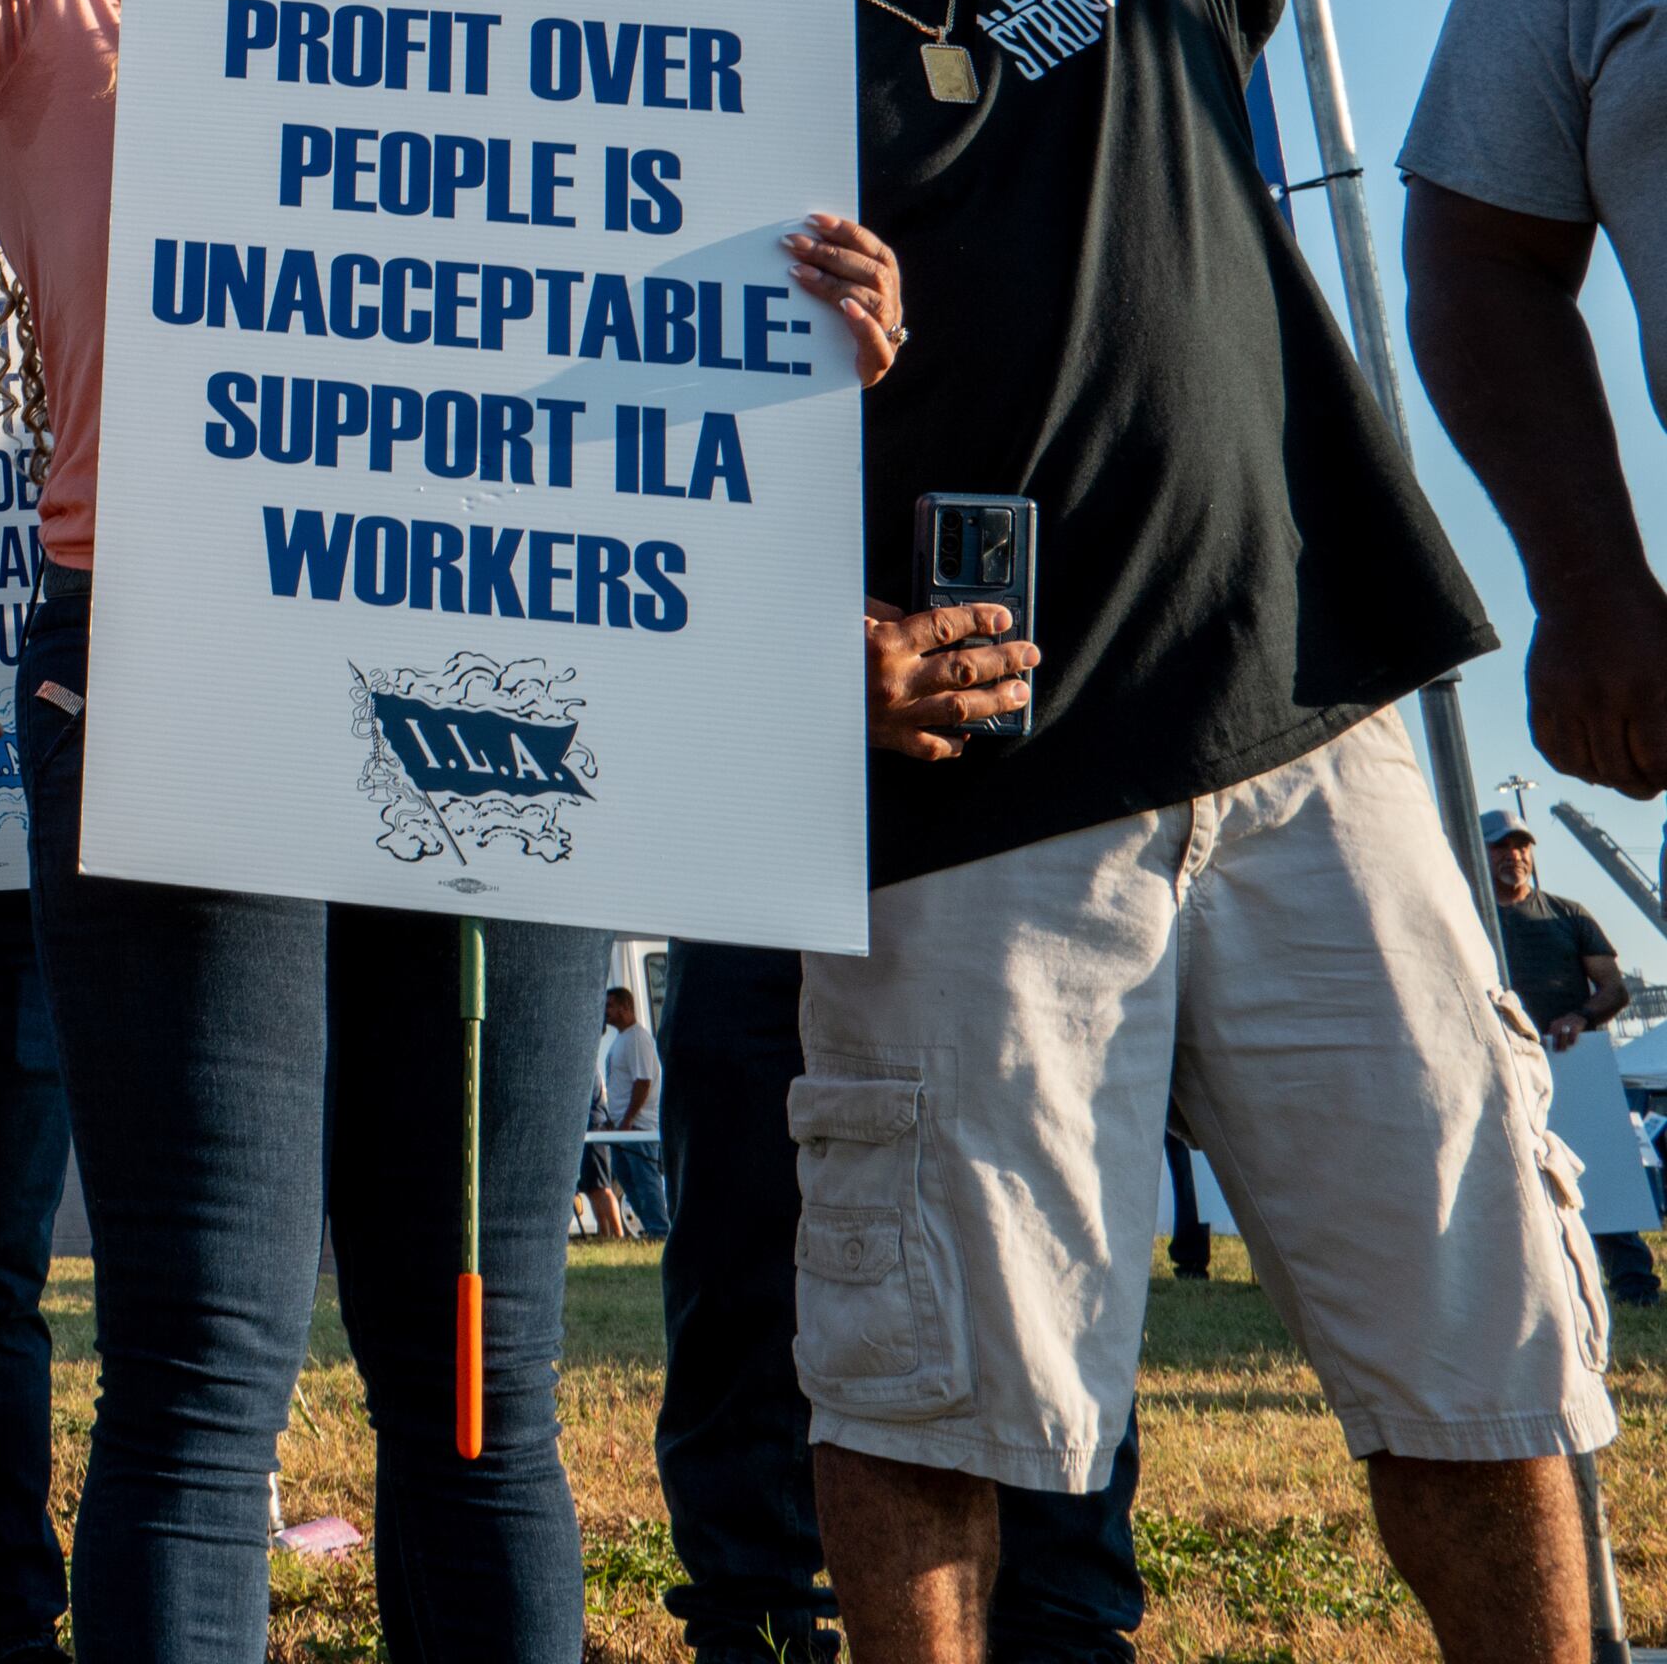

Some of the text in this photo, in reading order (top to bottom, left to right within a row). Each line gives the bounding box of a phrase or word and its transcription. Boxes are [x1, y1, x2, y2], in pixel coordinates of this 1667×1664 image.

[529, 17, 744, 114] OVER
[279, 123, 683, 235] PEOPLE IS
[152, 238, 812, 375] UNACCEPTABLE:
[204, 370, 752, 504] SUPPORT ILA
[263, 505, 689, 633] WORKERS
[404, 716, 564, 782] I.L.A.
